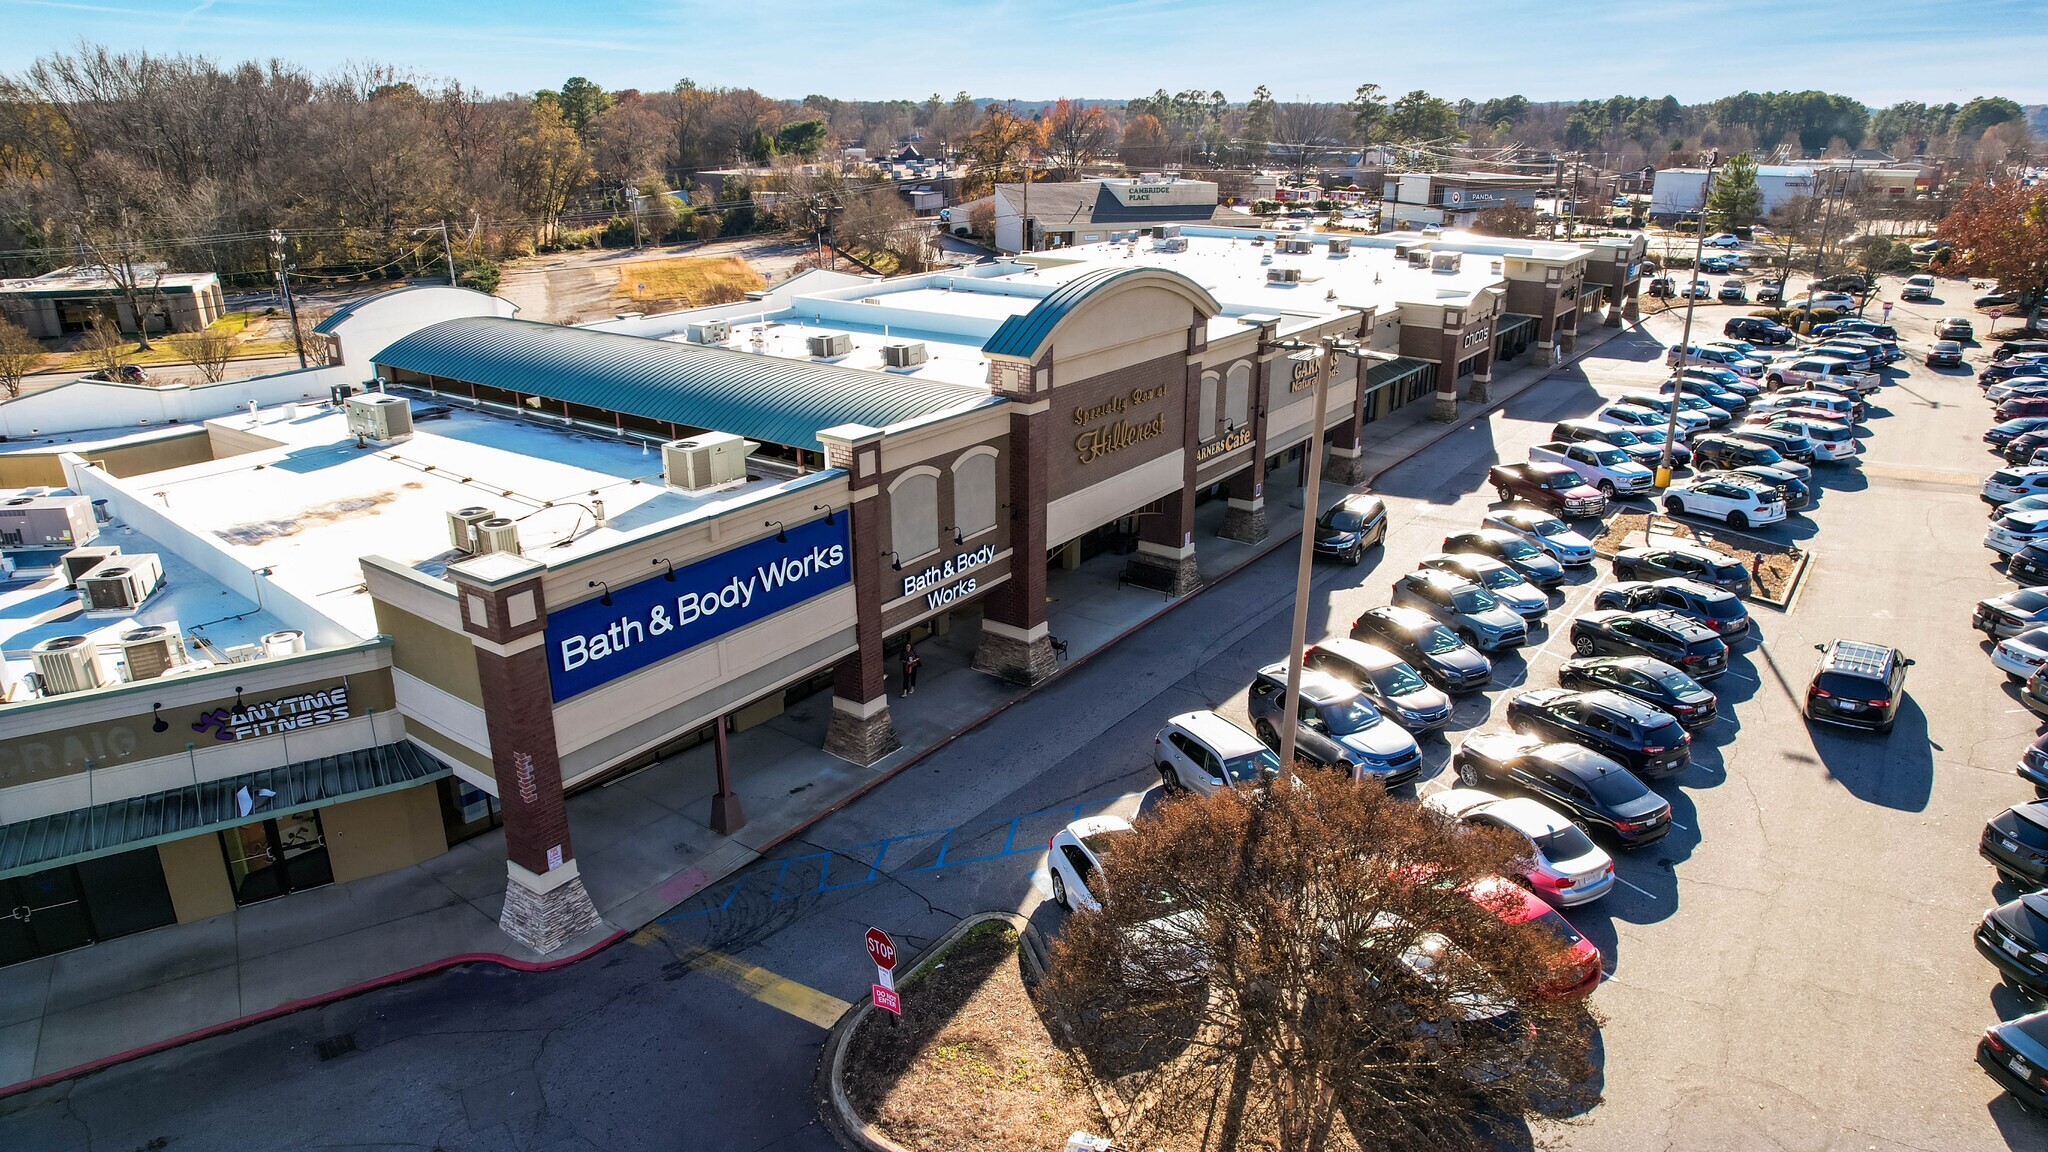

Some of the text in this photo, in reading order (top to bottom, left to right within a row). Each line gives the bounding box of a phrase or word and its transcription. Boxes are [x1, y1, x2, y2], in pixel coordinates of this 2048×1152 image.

[1294, 352, 1340, 380] GARNS
[1076, 412, 1166, 464] Hillcrest
[1196, 428, 1251, 461] ARNERS Cafe
[904, 544, 996, 597] Bath & Body
[561, 543, 844, 672] Bath & Body Works
[927, 578, 977, 610] Works
[230, 687, 348, 727] ANYTIME
[868, 938, 893, 959] STOP
[876, 989, 897, 1002] DO NOT
[878, 996, 897, 1009] ENTER
